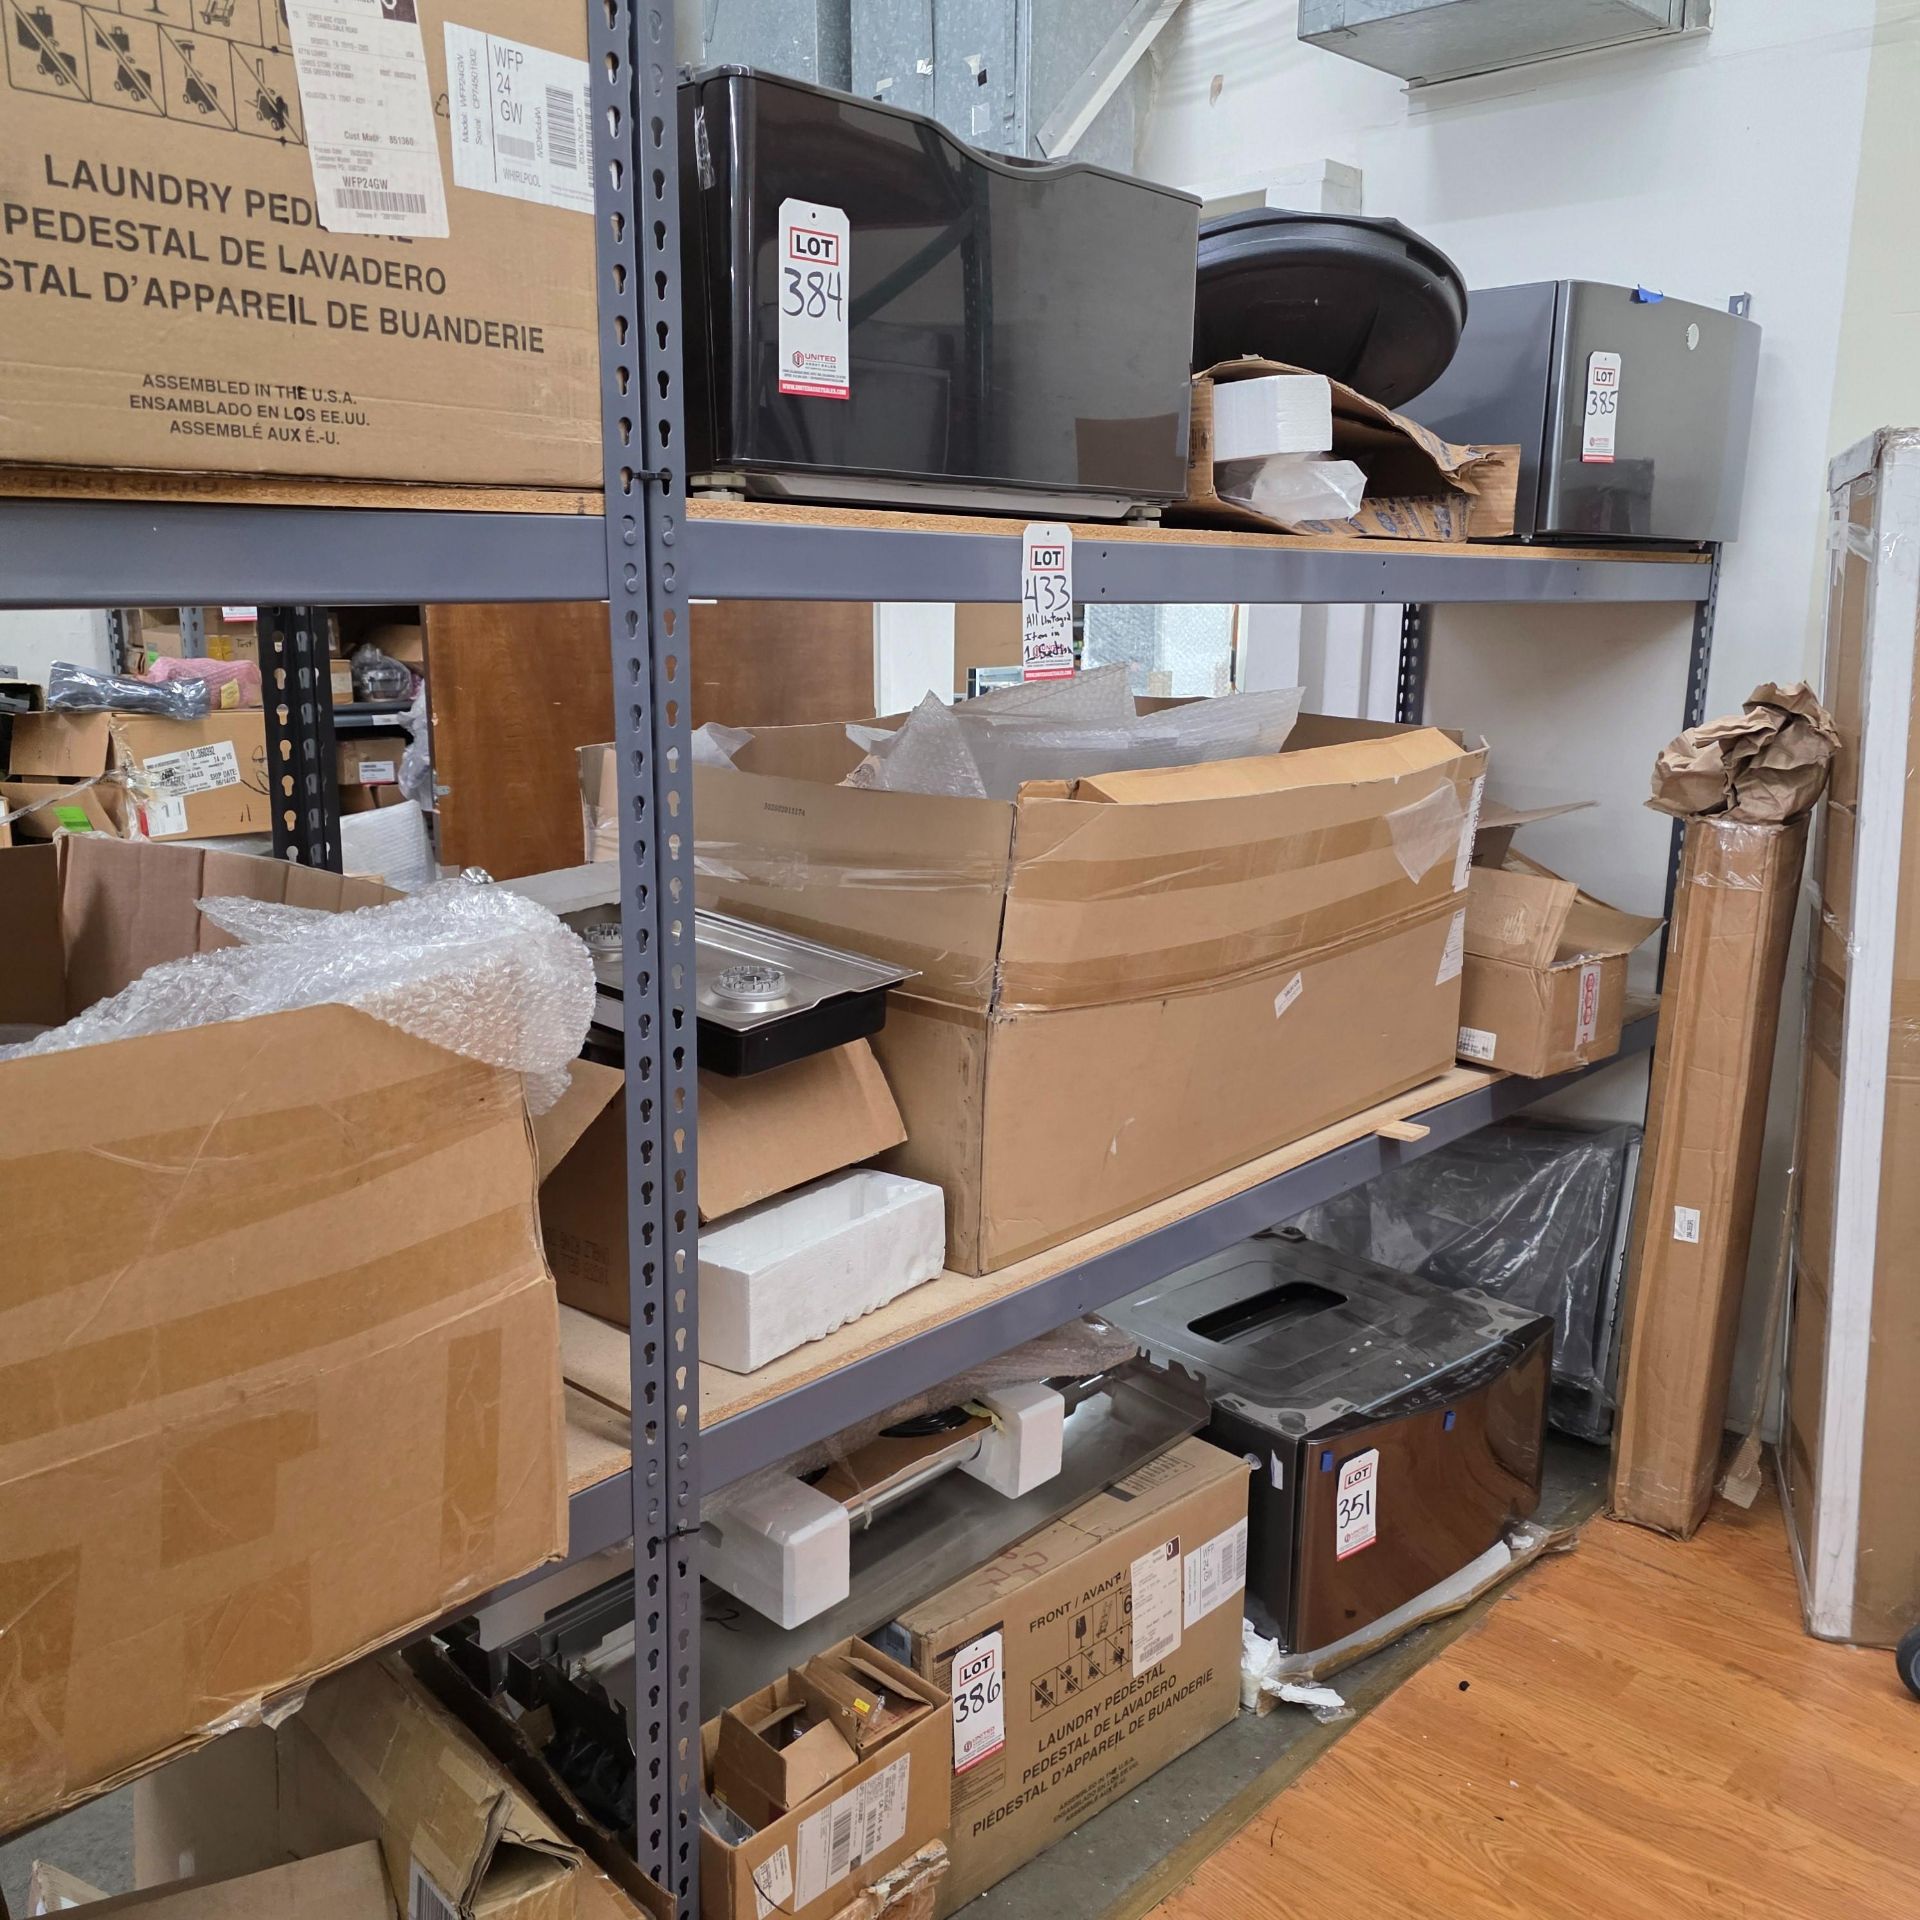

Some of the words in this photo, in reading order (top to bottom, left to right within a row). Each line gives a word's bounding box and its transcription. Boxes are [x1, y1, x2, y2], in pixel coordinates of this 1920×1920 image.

[494, 45, 523, 72] WFP
[496, 72, 511, 95] 24
[501, 100, 523, 125] GW
[45, 154, 232, 213] LAUNDRY
[342, 176, 388, 190] WFP24GW
[503, 167, 541, 188] WHIRLPOOL
[4, 203, 209, 263] PEDESTAL
[220, 235, 267, 270] DE
[278, 244, 446, 295] LAVADERO
[795, 234, 834, 258] LOT
[782, 267, 842, 321] 384
[103, 271, 317, 325] D'APPAREIL
[327, 300, 369, 332] DE
[380, 307, 545, 353] BUANDERIE
[804, 353, 837, 363] UNITED
[142, 374, 250, 395] ASSEMBLED
[255, 383, 271, 397] IN
[278, 385, 307, 401] THE
[312, 388, 357, 405] U.S.A.
[1596, 371, 1613, 382] LOT
[130, 395, 252, 417] ENSAMBLADO
[258, 405, 279, 419] EN
[284, 407, 316, 422] LOS
[321, 410, 371, 427] EE.UU.
[1587, 390, 1619, 416] 385
[170, 420, 263, 439] ASSEMBLÉ
[268, 427, 302, 443] AUX
[1034, 550, 1061, 566] LOT
[1024, 574, 1071, 613] 433
[1026, 613, 1039, 628] All
[1347, 1467, 1369, 1486] LOT
[1339, 1490, 1370, 1529] 351
[1029, 1600, 1072, 1634] FRONT
[1082, 1571, 1123, 1604] AVANT
[963, 1655, 991, 1681] LOT
[954, 1671, 1001, 1723] 386
[1038, 1703, 1101, 1754] LAUNDRY
[1104, 1662, 1166, 1711] PEDESTAL
[1022, 1732, 1090, 1785] PEDESTAL
[1093, 1720, 1111, 1739] DE
[1114, 1674, 1178, 1726] LAVADERO
[972, 1784, 1048, 1837] PIÉDESTAL
[1128, 1716, 1146, 1735] DE
[1147, 1668, 1214, 1721] BUANDERIE
